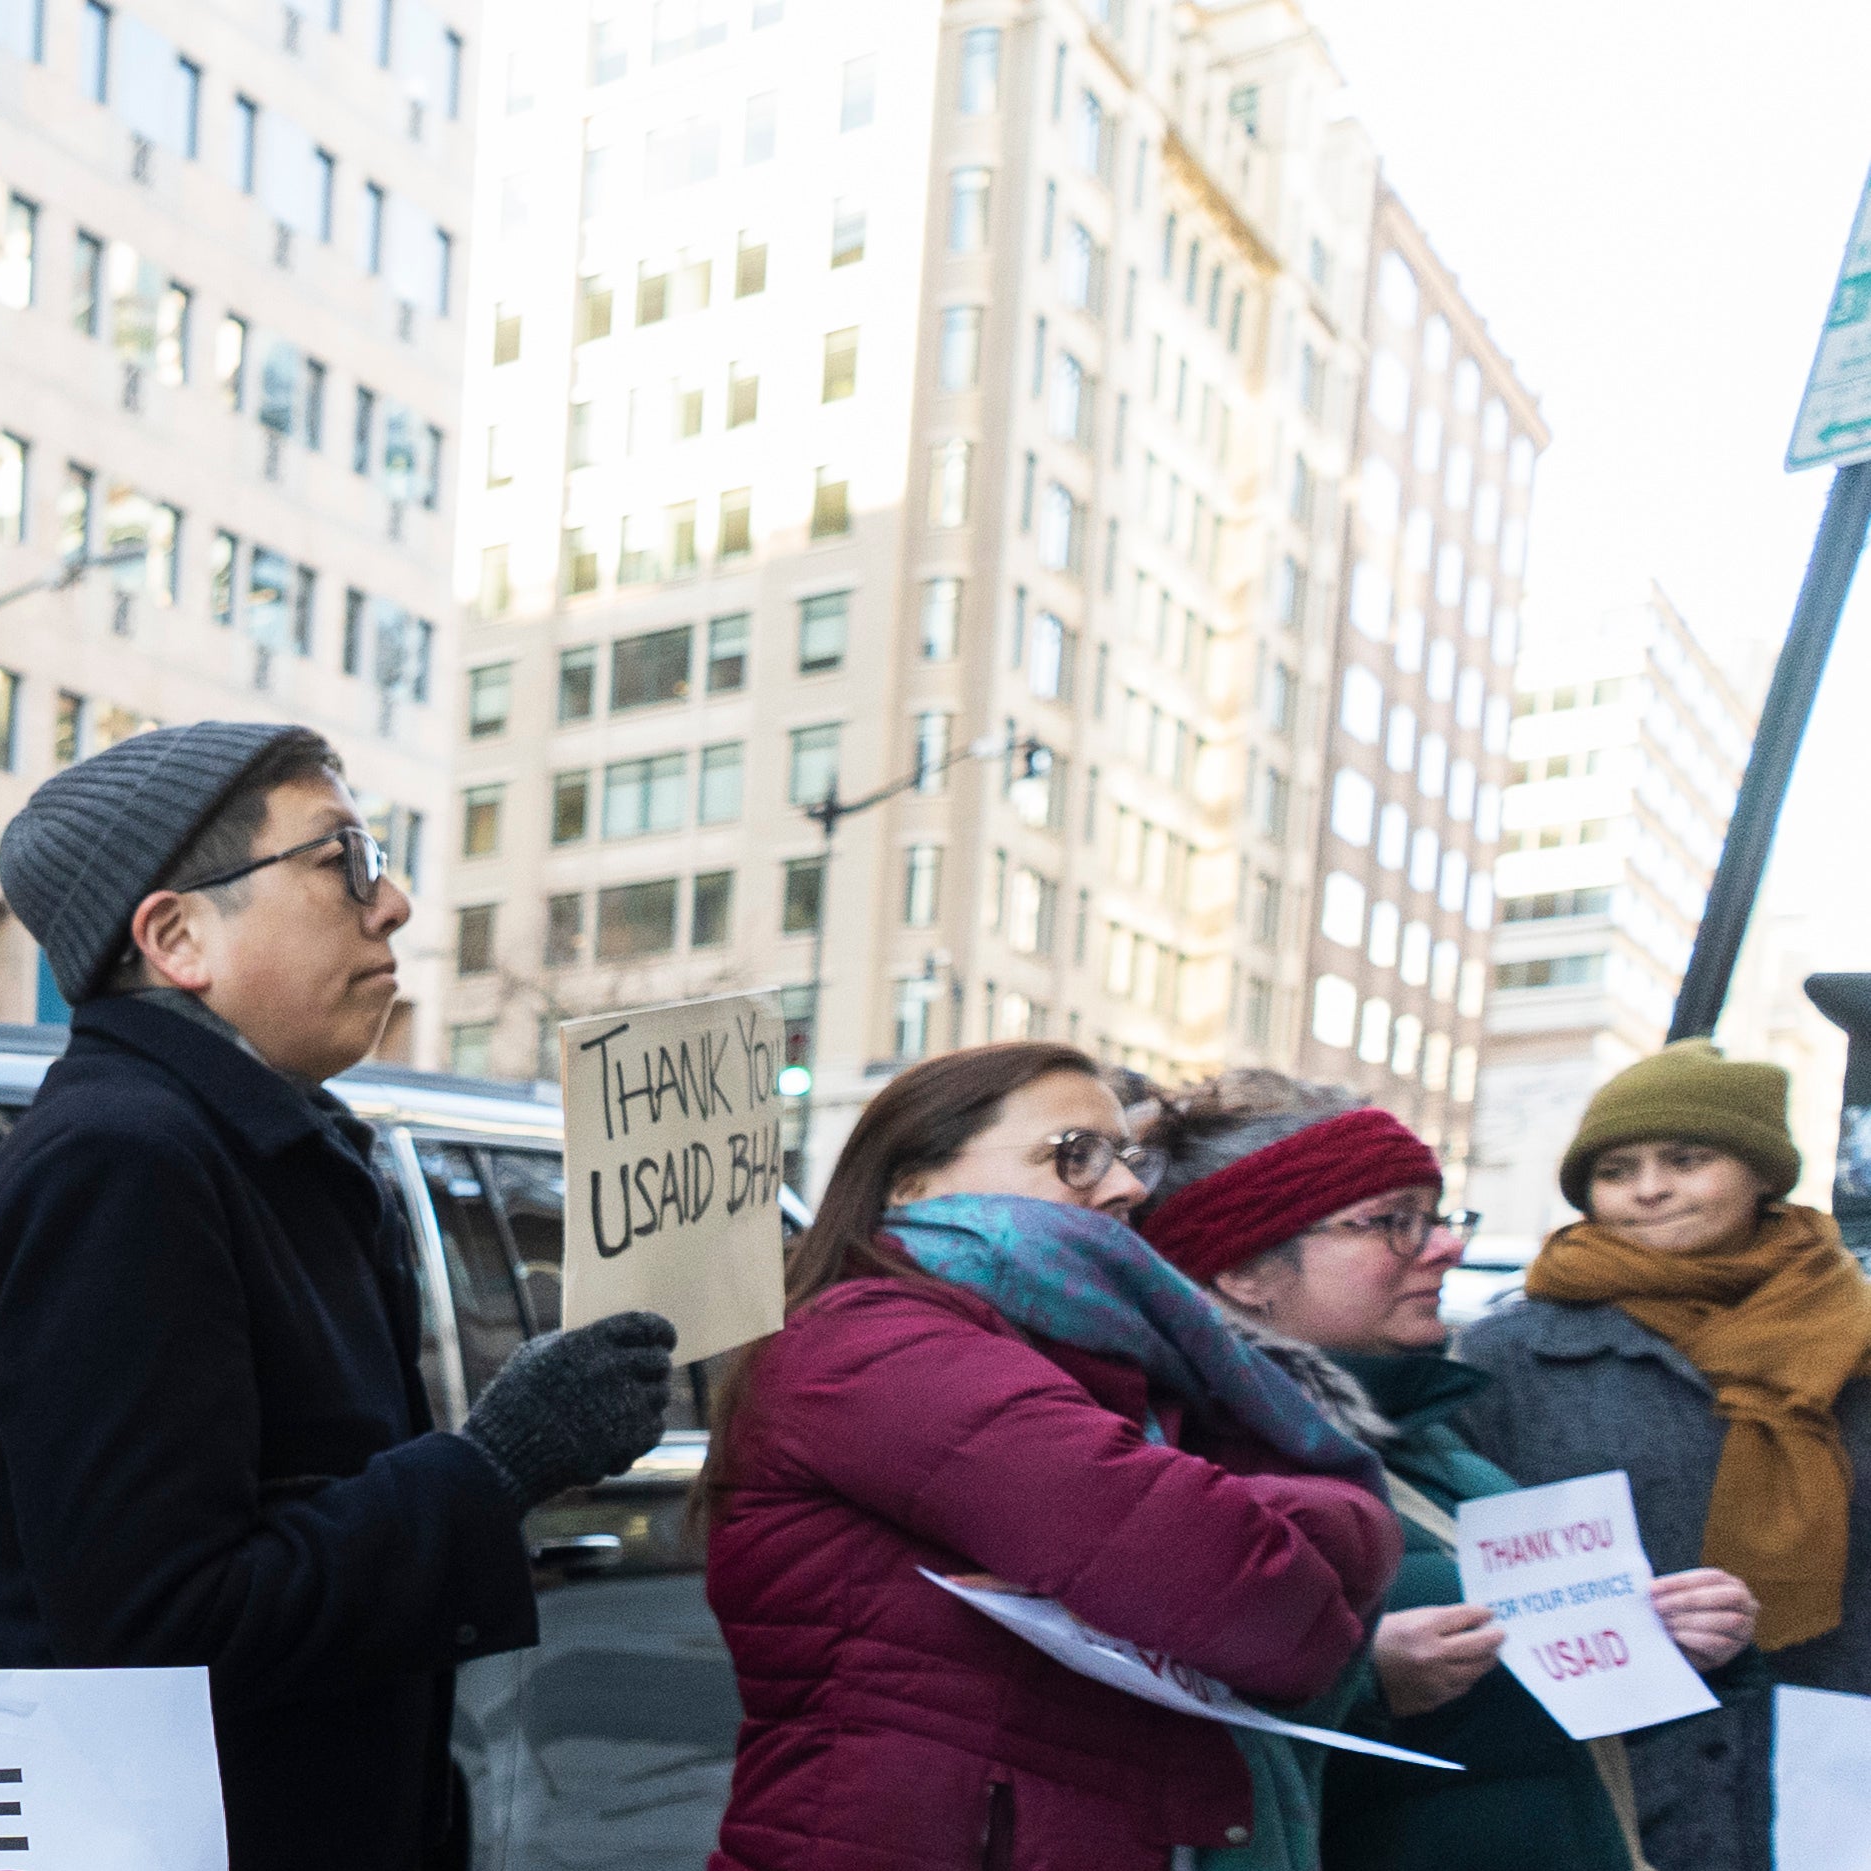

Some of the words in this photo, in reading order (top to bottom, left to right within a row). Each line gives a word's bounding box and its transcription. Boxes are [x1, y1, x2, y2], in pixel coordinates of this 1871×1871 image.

[580, 1022, 734, 1141] THANK
[590, 1140, 715, 1259] USAID
[726, 1117, 780, 1217] BHA
[1477, 1530, 1560, 1573] THANK
[1562, 1519, 1613, 1555] YOU
[1522, 1588, 1566, 1615] YOUR
[1567, 1572, 1634, 1605] SERVICE
[1530, 1628, 1630, 1682] USAID
